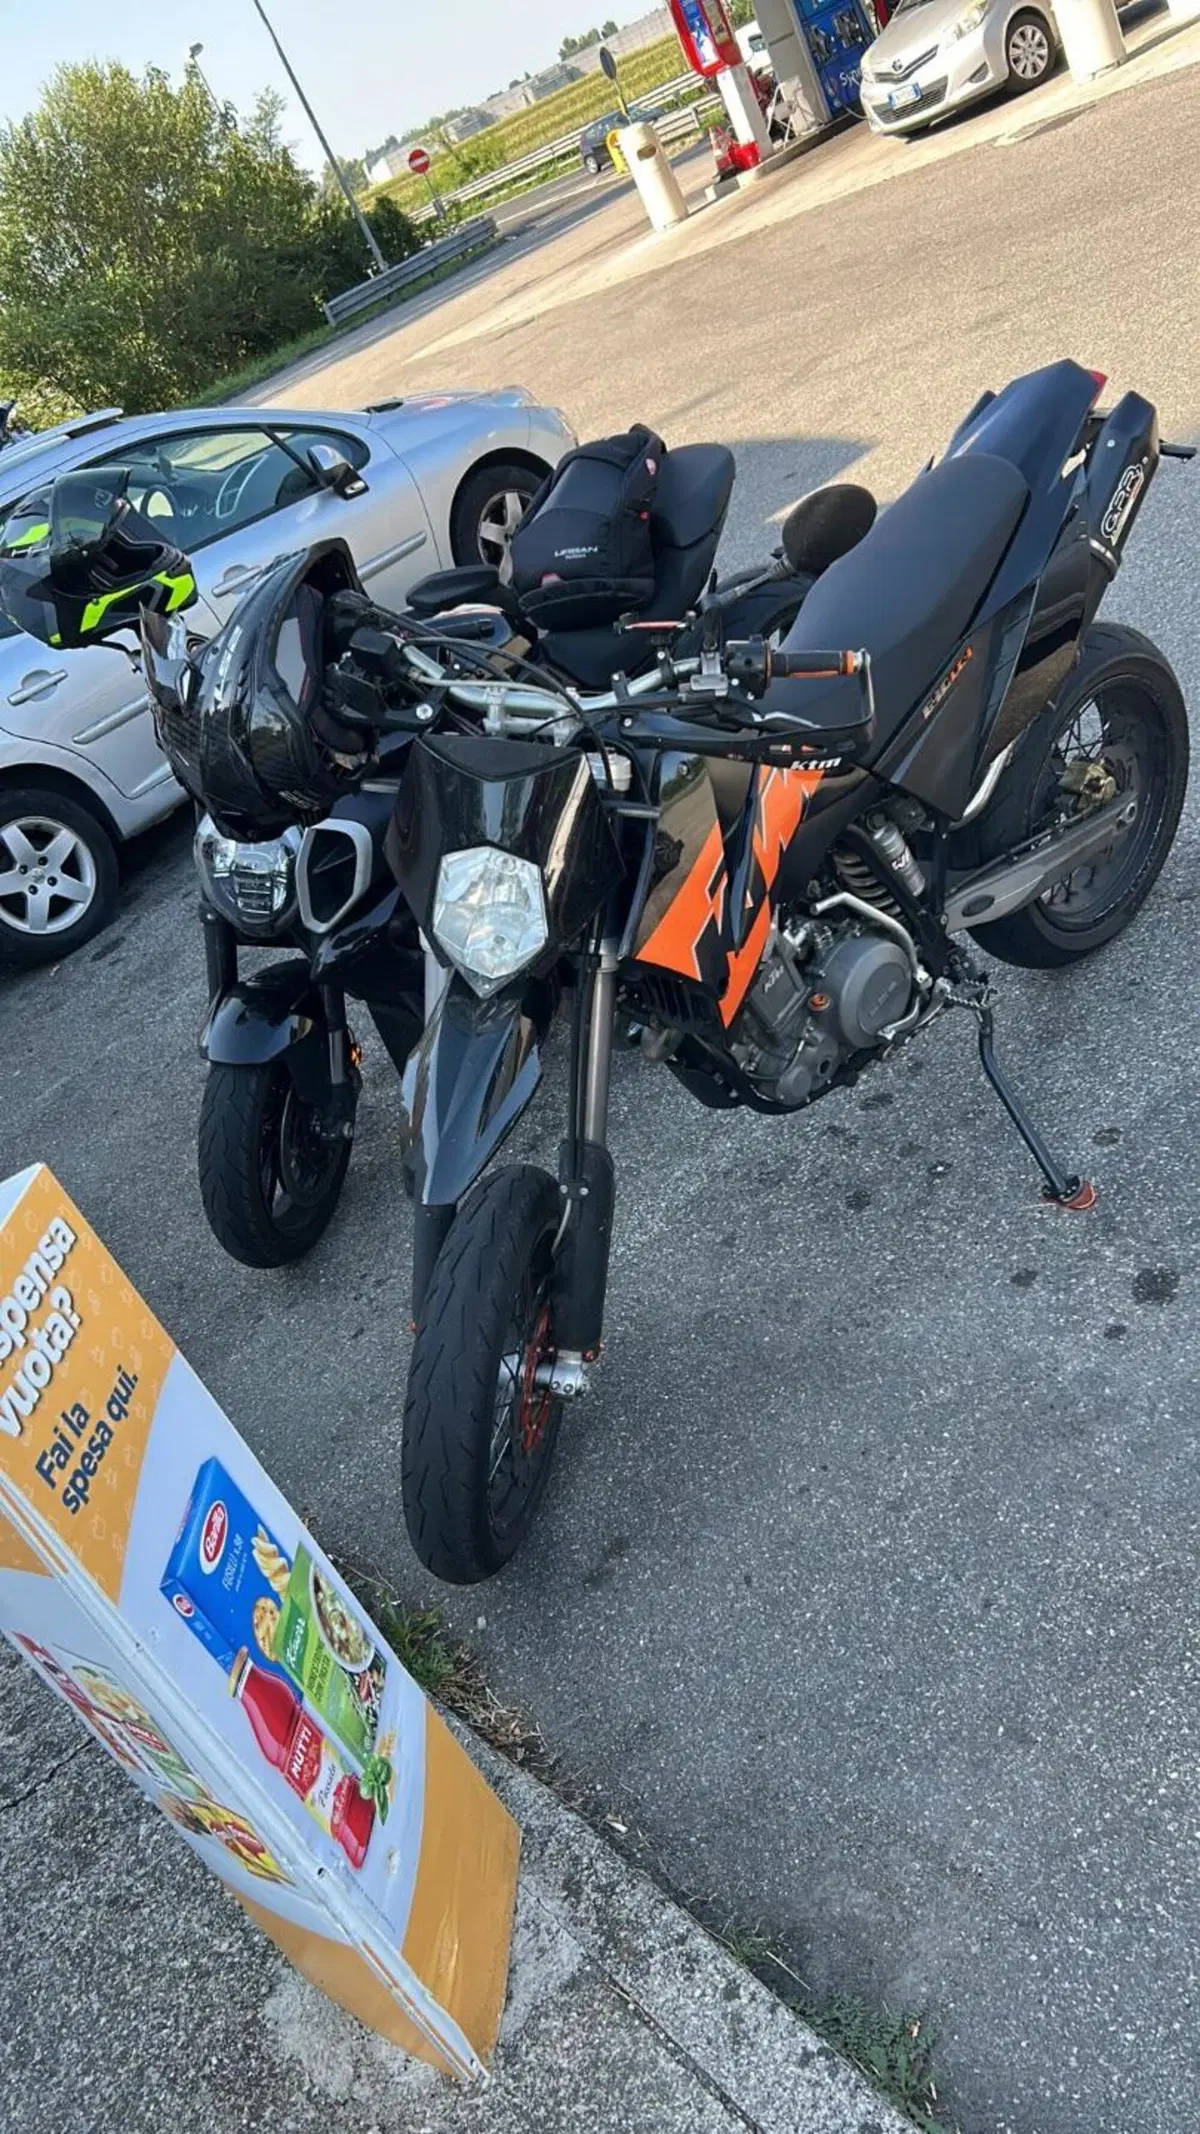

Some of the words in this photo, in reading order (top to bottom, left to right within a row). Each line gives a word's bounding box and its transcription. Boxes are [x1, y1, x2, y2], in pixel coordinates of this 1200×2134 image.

[0, 1286, 81, 1438] vuota?
[35, 1425, 75, 1490] Fai
[60, 1402, 91, 1439] la
[62, 1419, 114, 1515] spesa
[106, 1363, 139, 1422] qui.
[204, 1504, 225, 1560] Barilla
[291, 1725, 313, 1780] MUTTI
